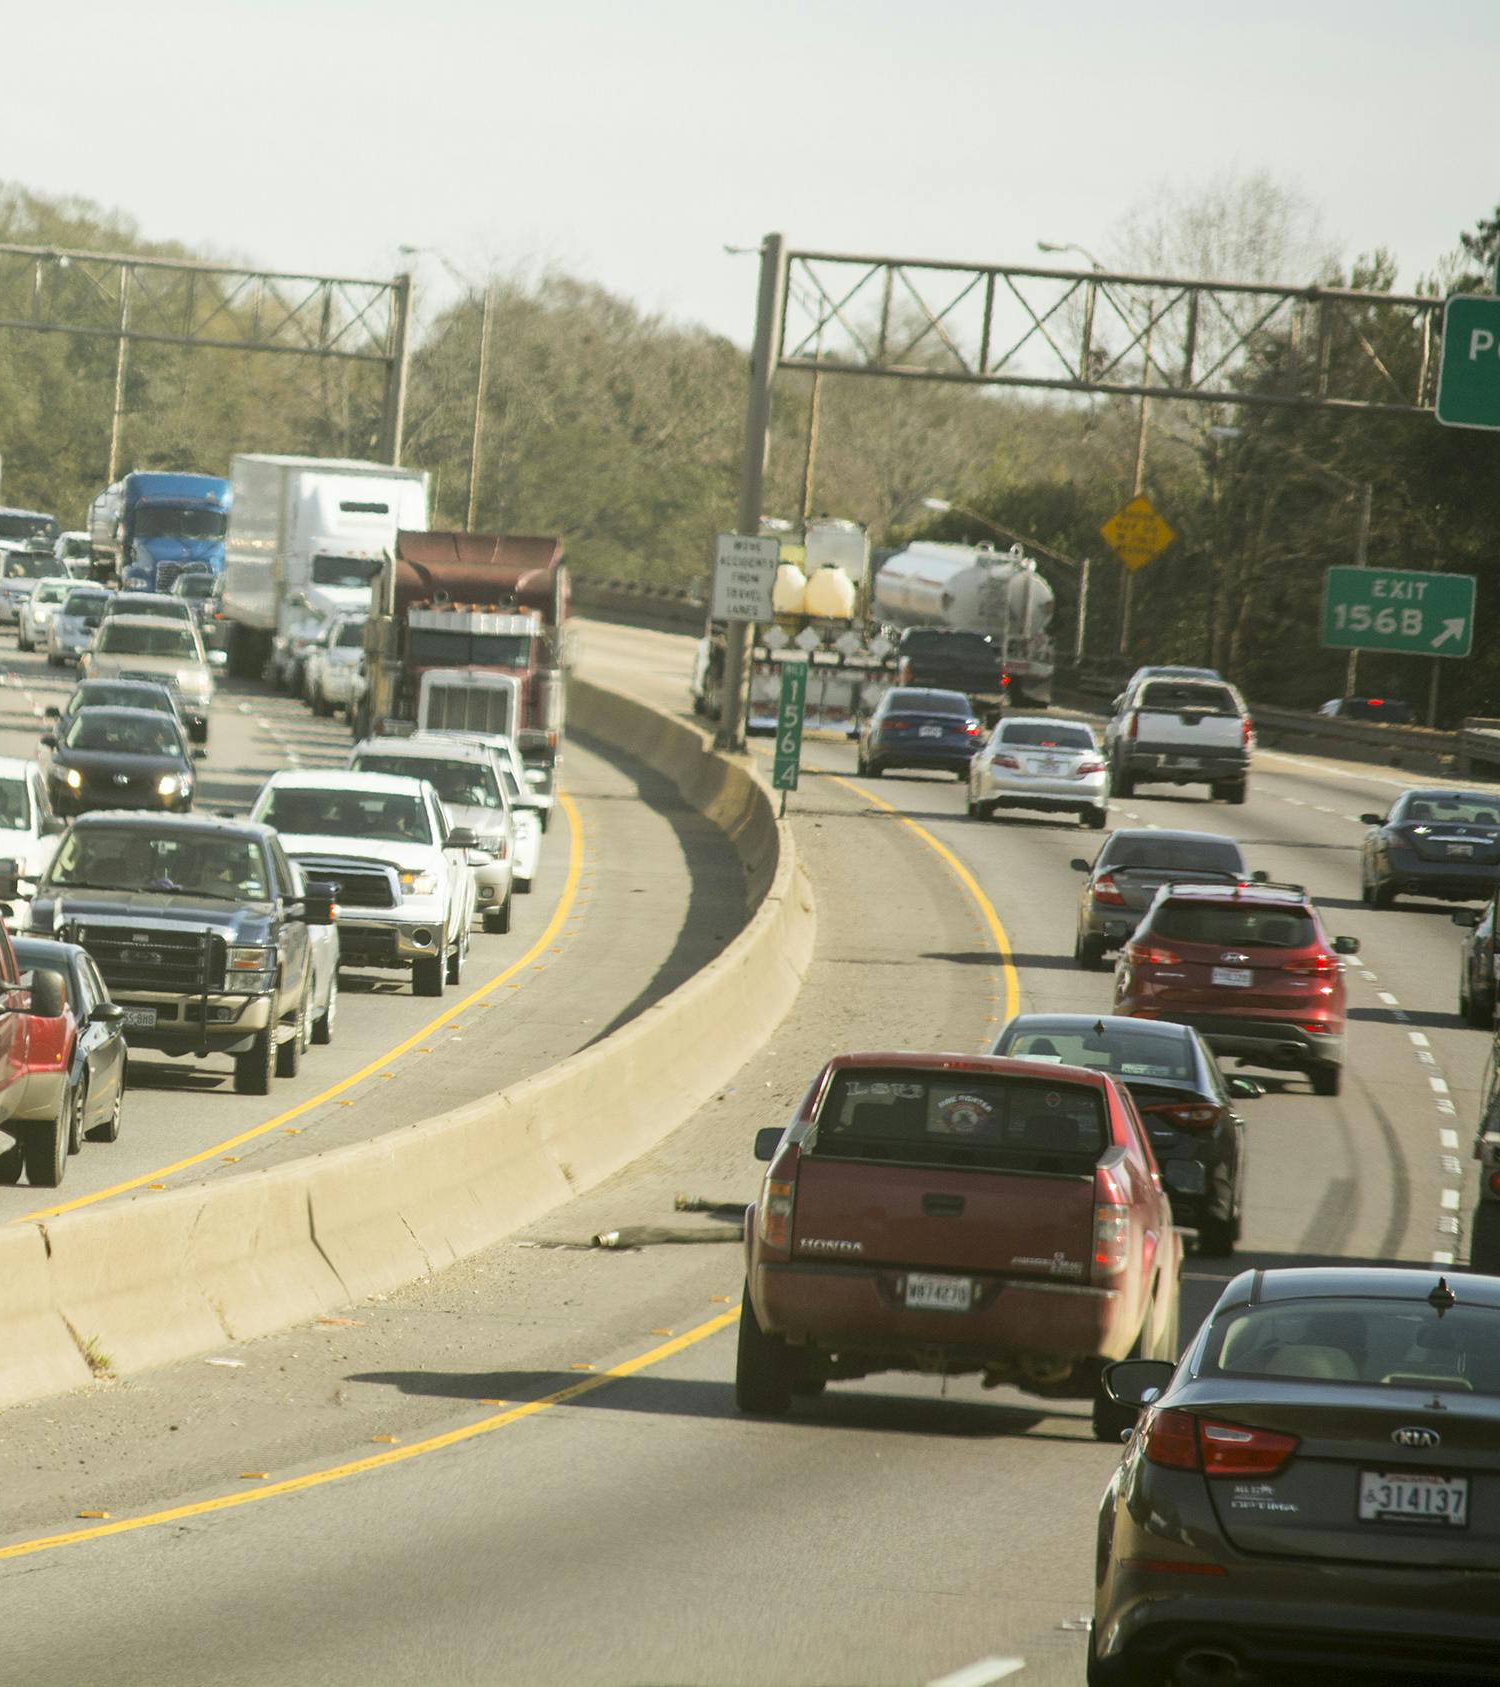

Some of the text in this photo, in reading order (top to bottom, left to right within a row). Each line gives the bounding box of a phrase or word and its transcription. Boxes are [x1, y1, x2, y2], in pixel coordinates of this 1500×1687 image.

[1468, 328, 1500, 362] P
[1372, 579, 1428, 600] EXIT
[1334, 603, 1423, 636] 156B
[845, 1081, 925, 1099] LSU
[800, 1238, 863, 1253] HONDA
[1400, 1430, 1432, 1446] KIA
[1379, 1485, 1464, 1514] 314137
